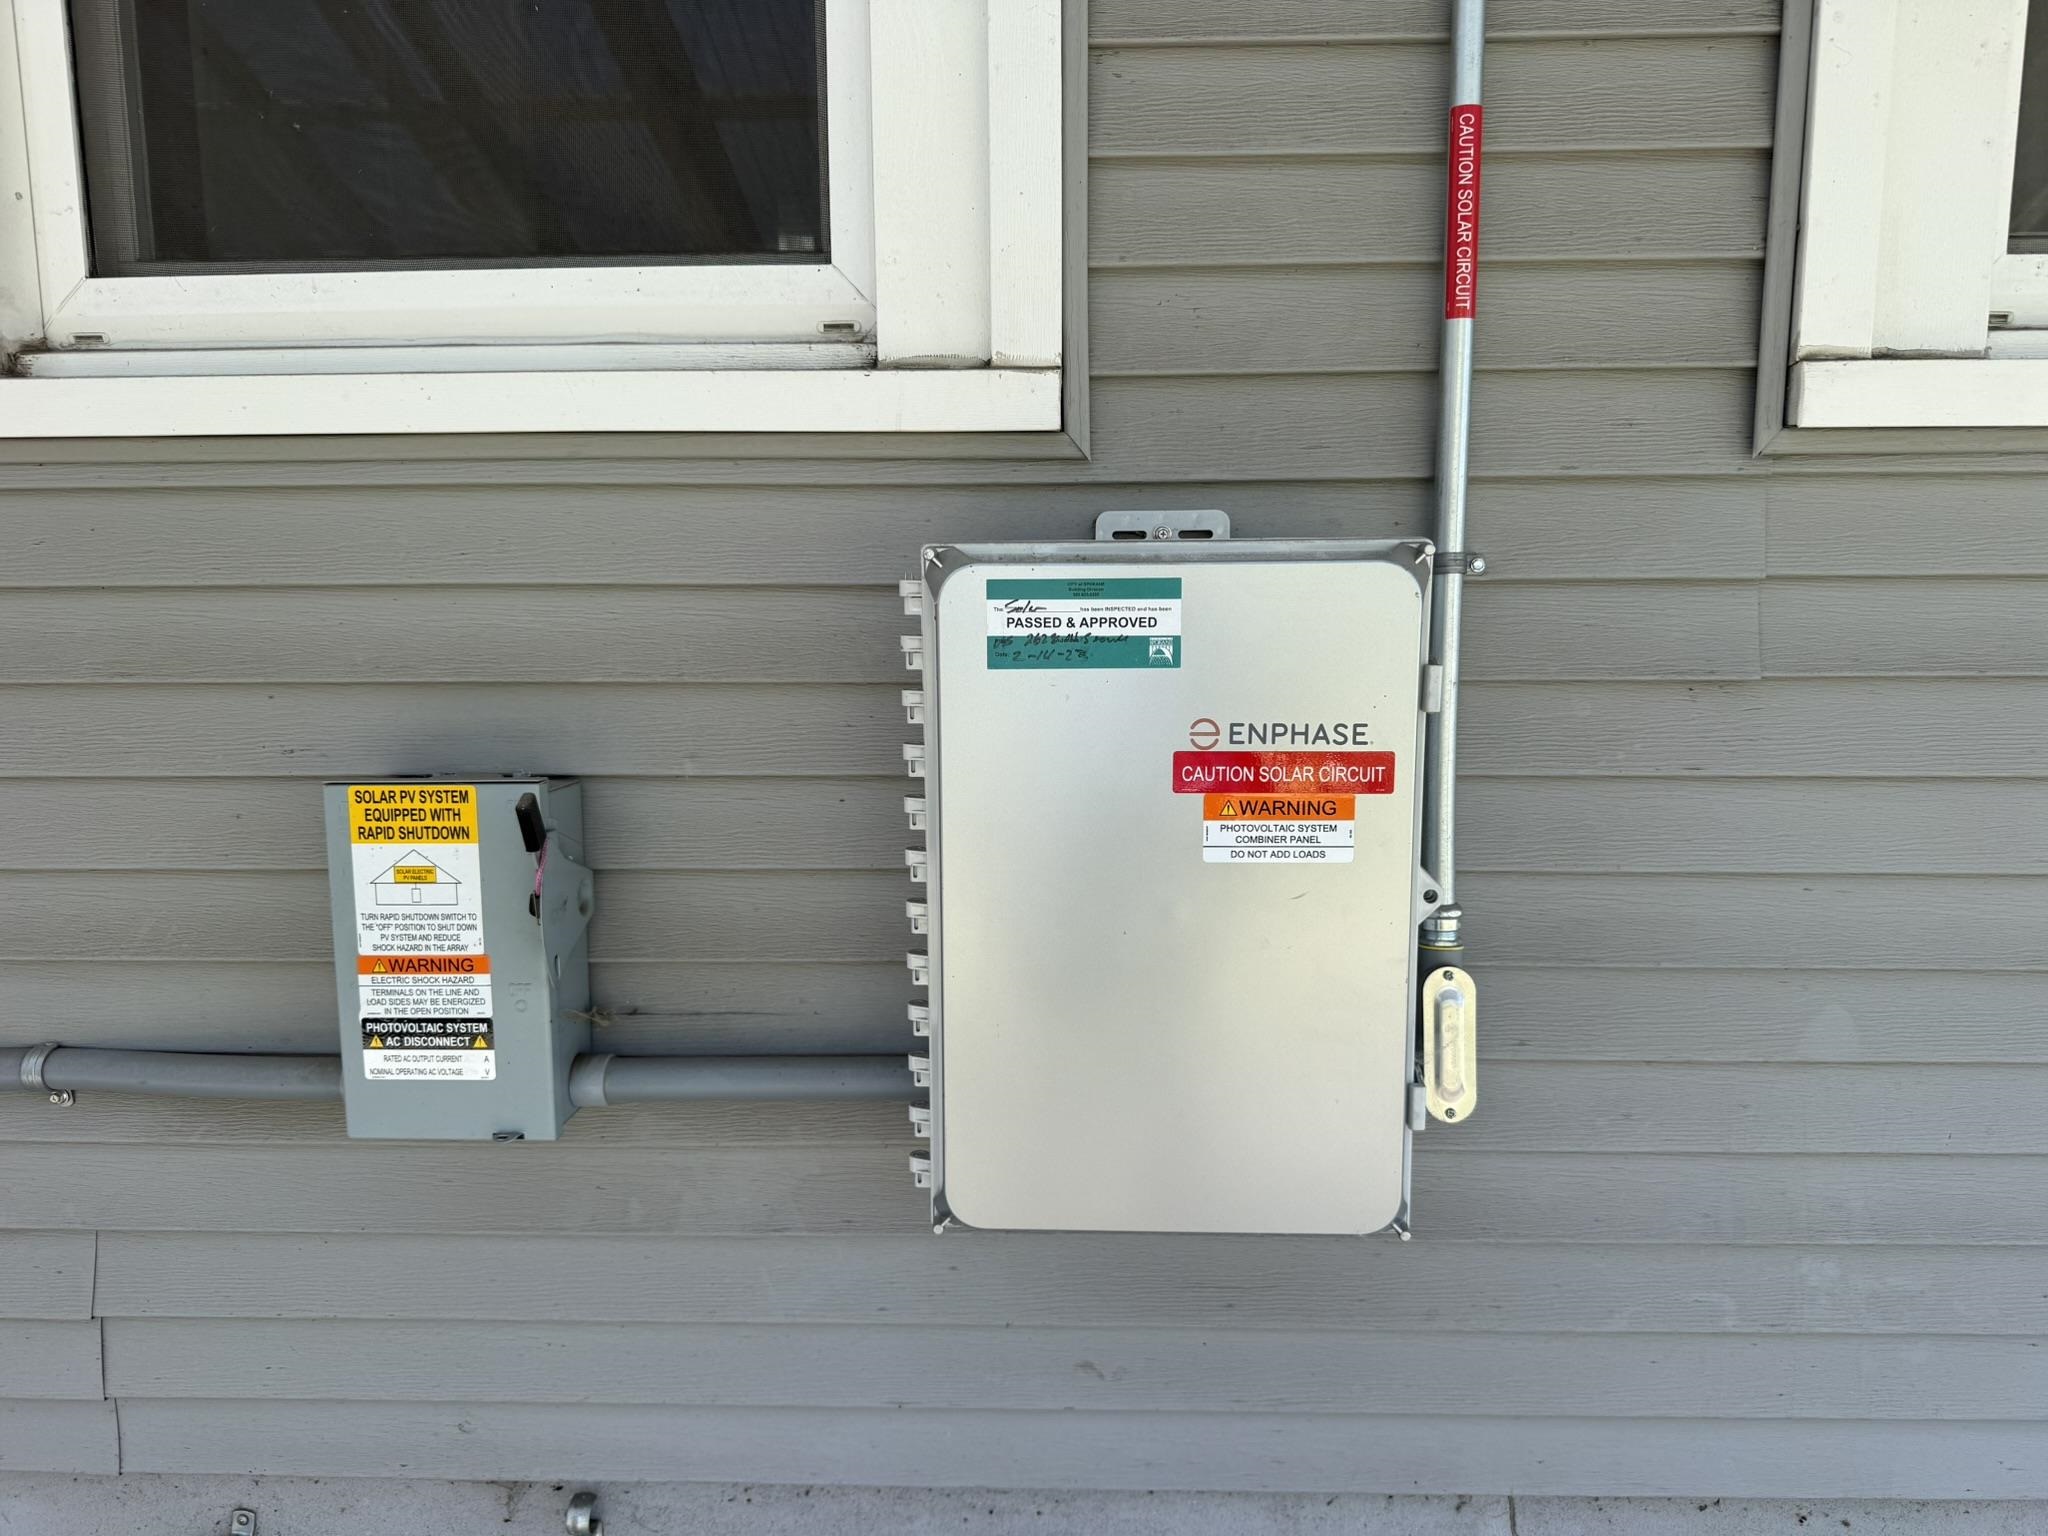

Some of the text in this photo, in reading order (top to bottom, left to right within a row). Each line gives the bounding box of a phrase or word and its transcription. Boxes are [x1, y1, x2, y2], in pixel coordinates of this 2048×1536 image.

[1455, 113, 1475, 310] CAUTION SOLAR CIRCUIT
[1007, 617, 1157, 628] PASSED & APPROVED
[1229, 722, 1369, 746] ENPHASE
[1182, 766, 1386, 782] CAUTION SOLAR CIRCUIT
[355, 790, 469, 804] SOLAR PV SYSTEM
[364, 808, 461, 822] EQUIPPED WITH
[1239, 800, 1337, 816] WARNING
[358, 826, 470, 840] RAPID SHUTDOWN
[1220, 824, 1337, 832] PHOTOVOLTAIC SYSTEM
[1236, 836, 1321, 844] COMBINER PANEL
[388, 958, 474, 972] WARNING
[366, 1023, 488, 1033] PHOTOVOLTAIC SYSTEM
[386, 1037, 471, 1046] AC DISCONNECT
